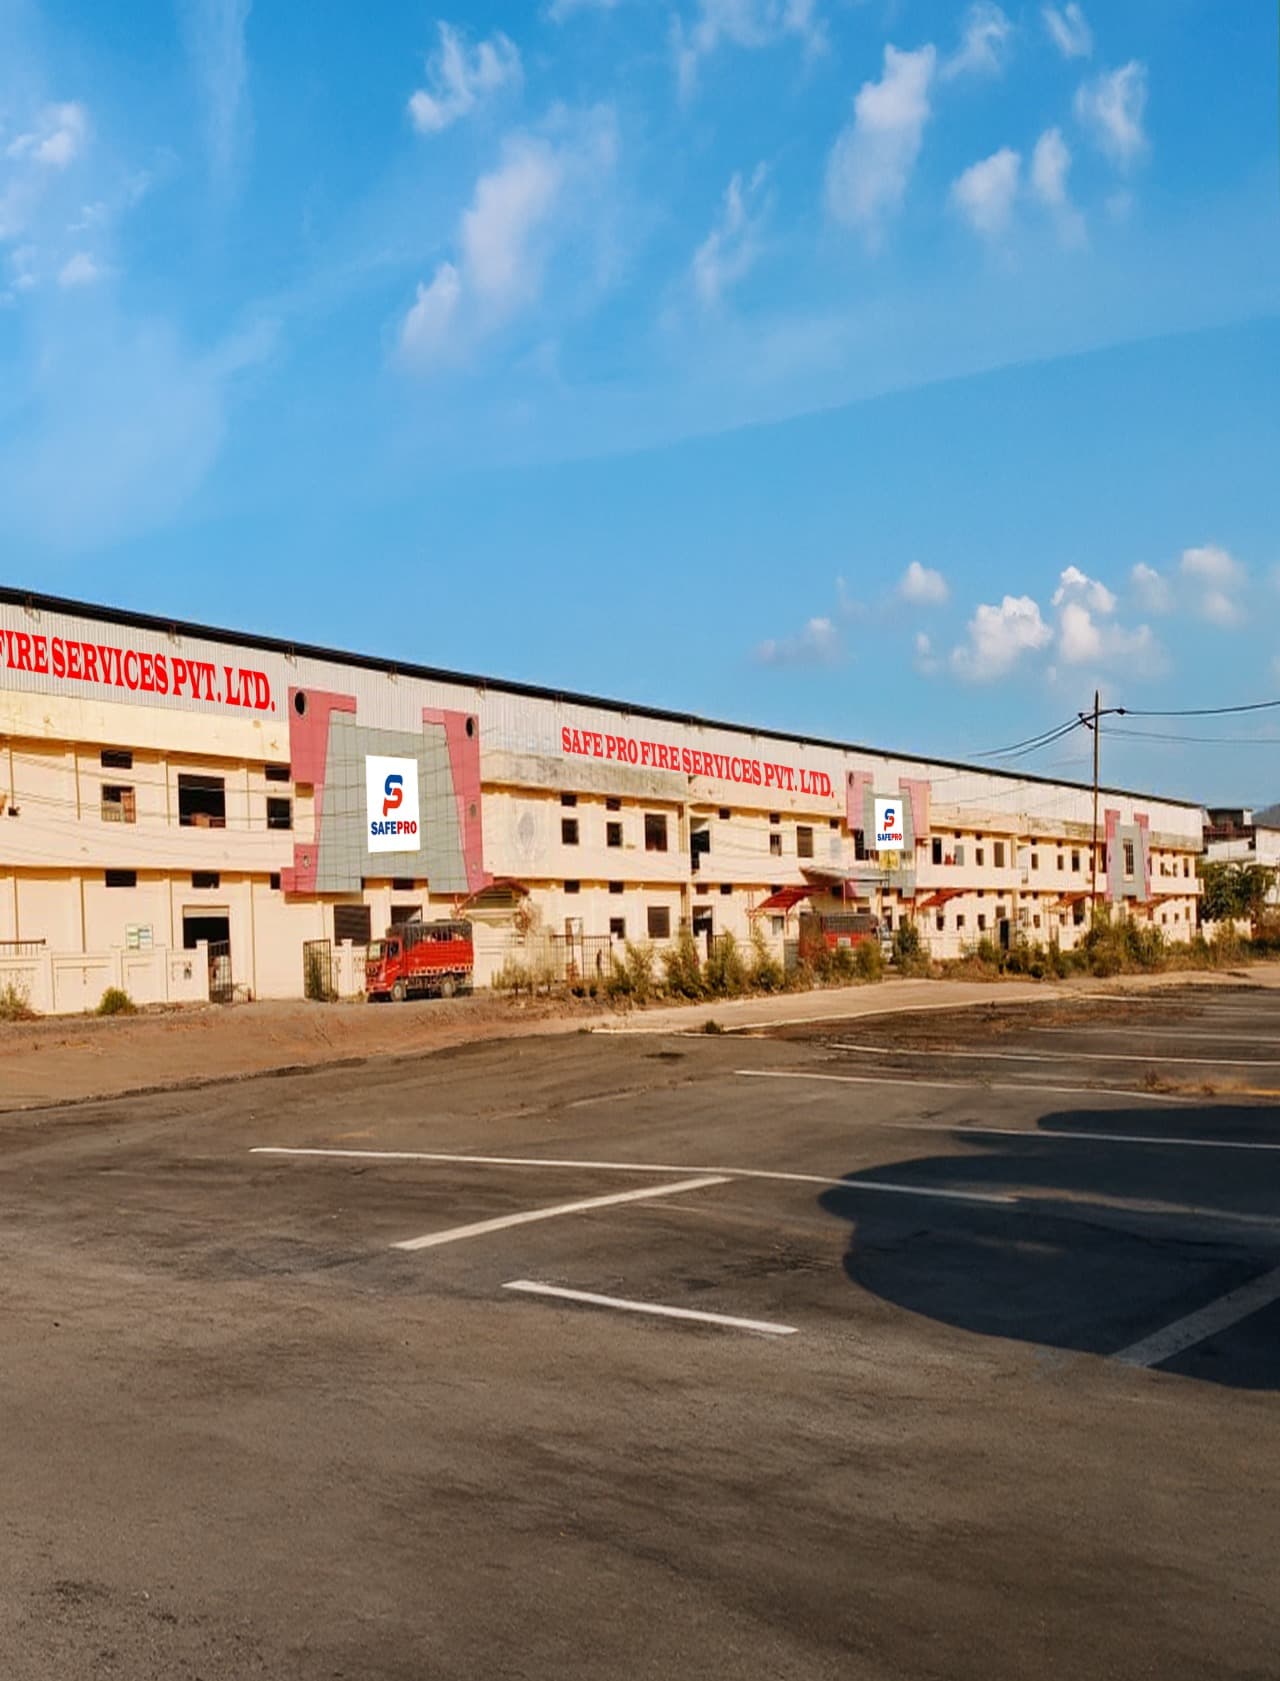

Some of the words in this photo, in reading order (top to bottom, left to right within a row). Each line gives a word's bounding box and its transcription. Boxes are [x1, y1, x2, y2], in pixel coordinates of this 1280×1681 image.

[51, 637, 168, 695] SERVICES
[171, 657, 222, 703] PVT.
[224, 666, 276, 711] LTD.
[561, 726, 604, 758] SAFE
[606, 735, 639, 766] PRO
[640, 741, 680, 772] FIRE
[682, 748, 762, 786] SERVICES
[764, 762, 798, 792] PVT.
[800, 769, 835, 798] LTD.
[371, 820, 418, 835] SAFEPRO
[877, 833, 903, 842] SAFEPRO
